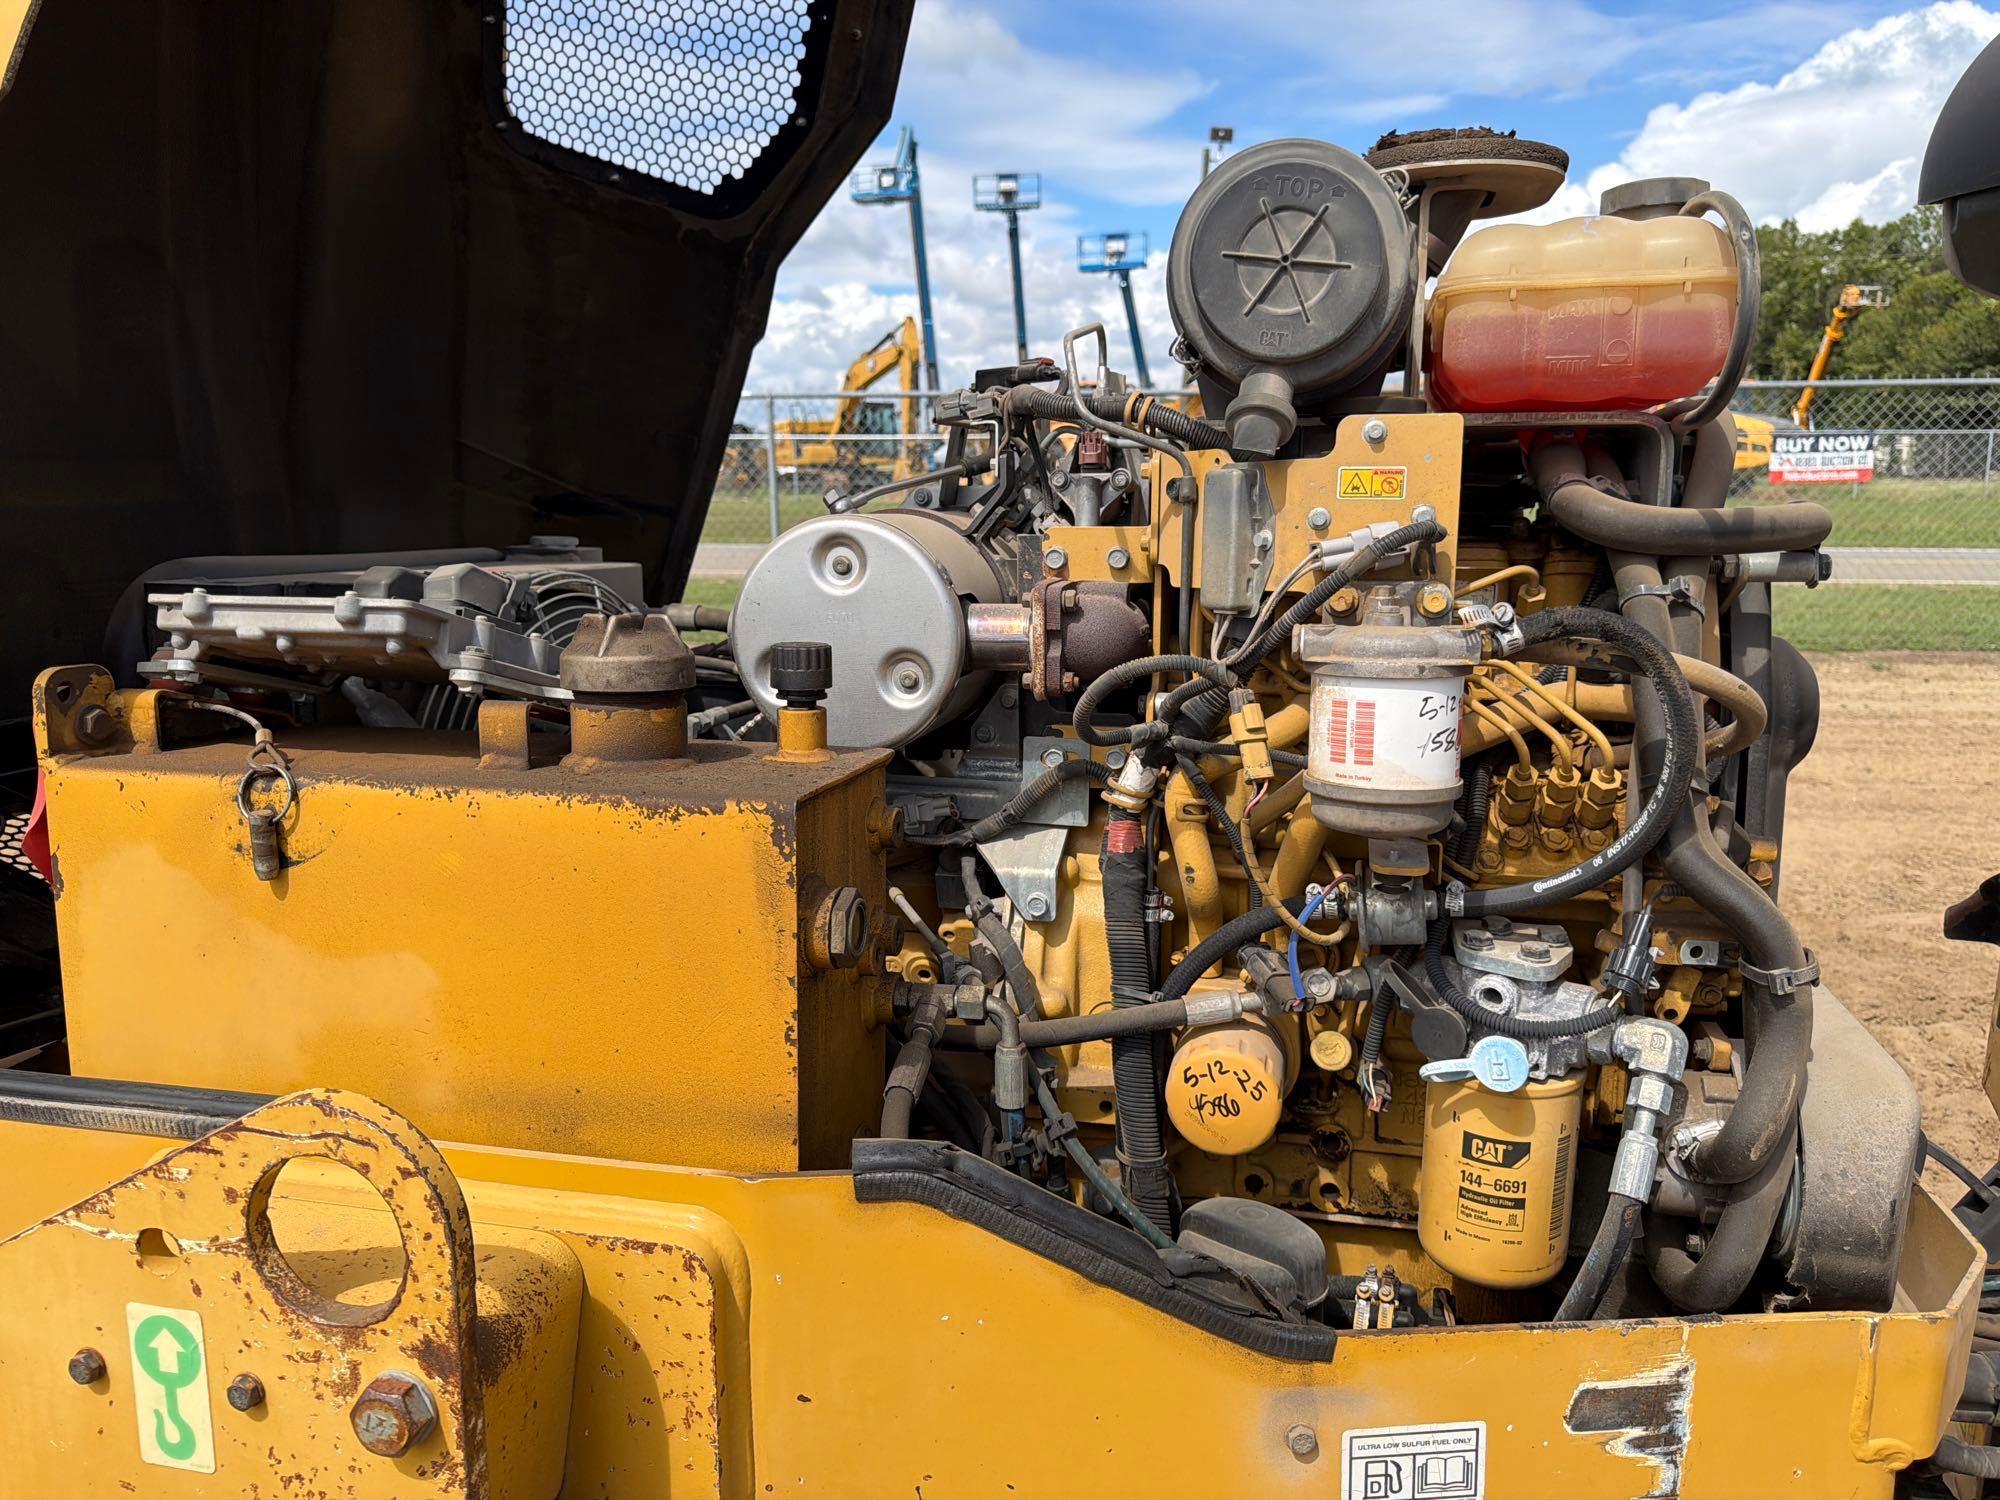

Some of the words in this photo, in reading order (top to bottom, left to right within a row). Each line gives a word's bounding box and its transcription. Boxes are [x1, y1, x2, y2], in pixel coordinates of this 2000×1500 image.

[1275, 175, 1324, 199] TOP
[1259, 331, 1288, 348] CAT
[1775, 437, 1815, 453] BUY
[1819, 435, 1870, 452] NOW
[1664, 749, 1673, 767] PSI
[1661, 766, 1670, 783] 300
[1592, 855, 1603, 867] 06
[1533, 870, 1578, 893] Continental
[1183, 1060, 1231, 1088] 5-12
[1471, 1138, 1507, 1164] CAT
[1460, 1169, 1527, 1194] 144-6691
[1461, 1189, 1489, 1203] Hydraulic
[1499, 1198, 1515, 1207] Filter
[1460, 1203, 1488, 1216] Advanced
[1460, 1209, 1473, 1218] High
[1473, 1214, 1503, 1226] Efficiency
[1455, 1227, 1468, 1236] Made
[1473, 1234, 1491, 1242] Mexico
[1401, 1440, 1431, 1448] SULFUR
[1452, 1437, 1473, 1445] ONLY
[1369, 1481, 1382, 1494] D
